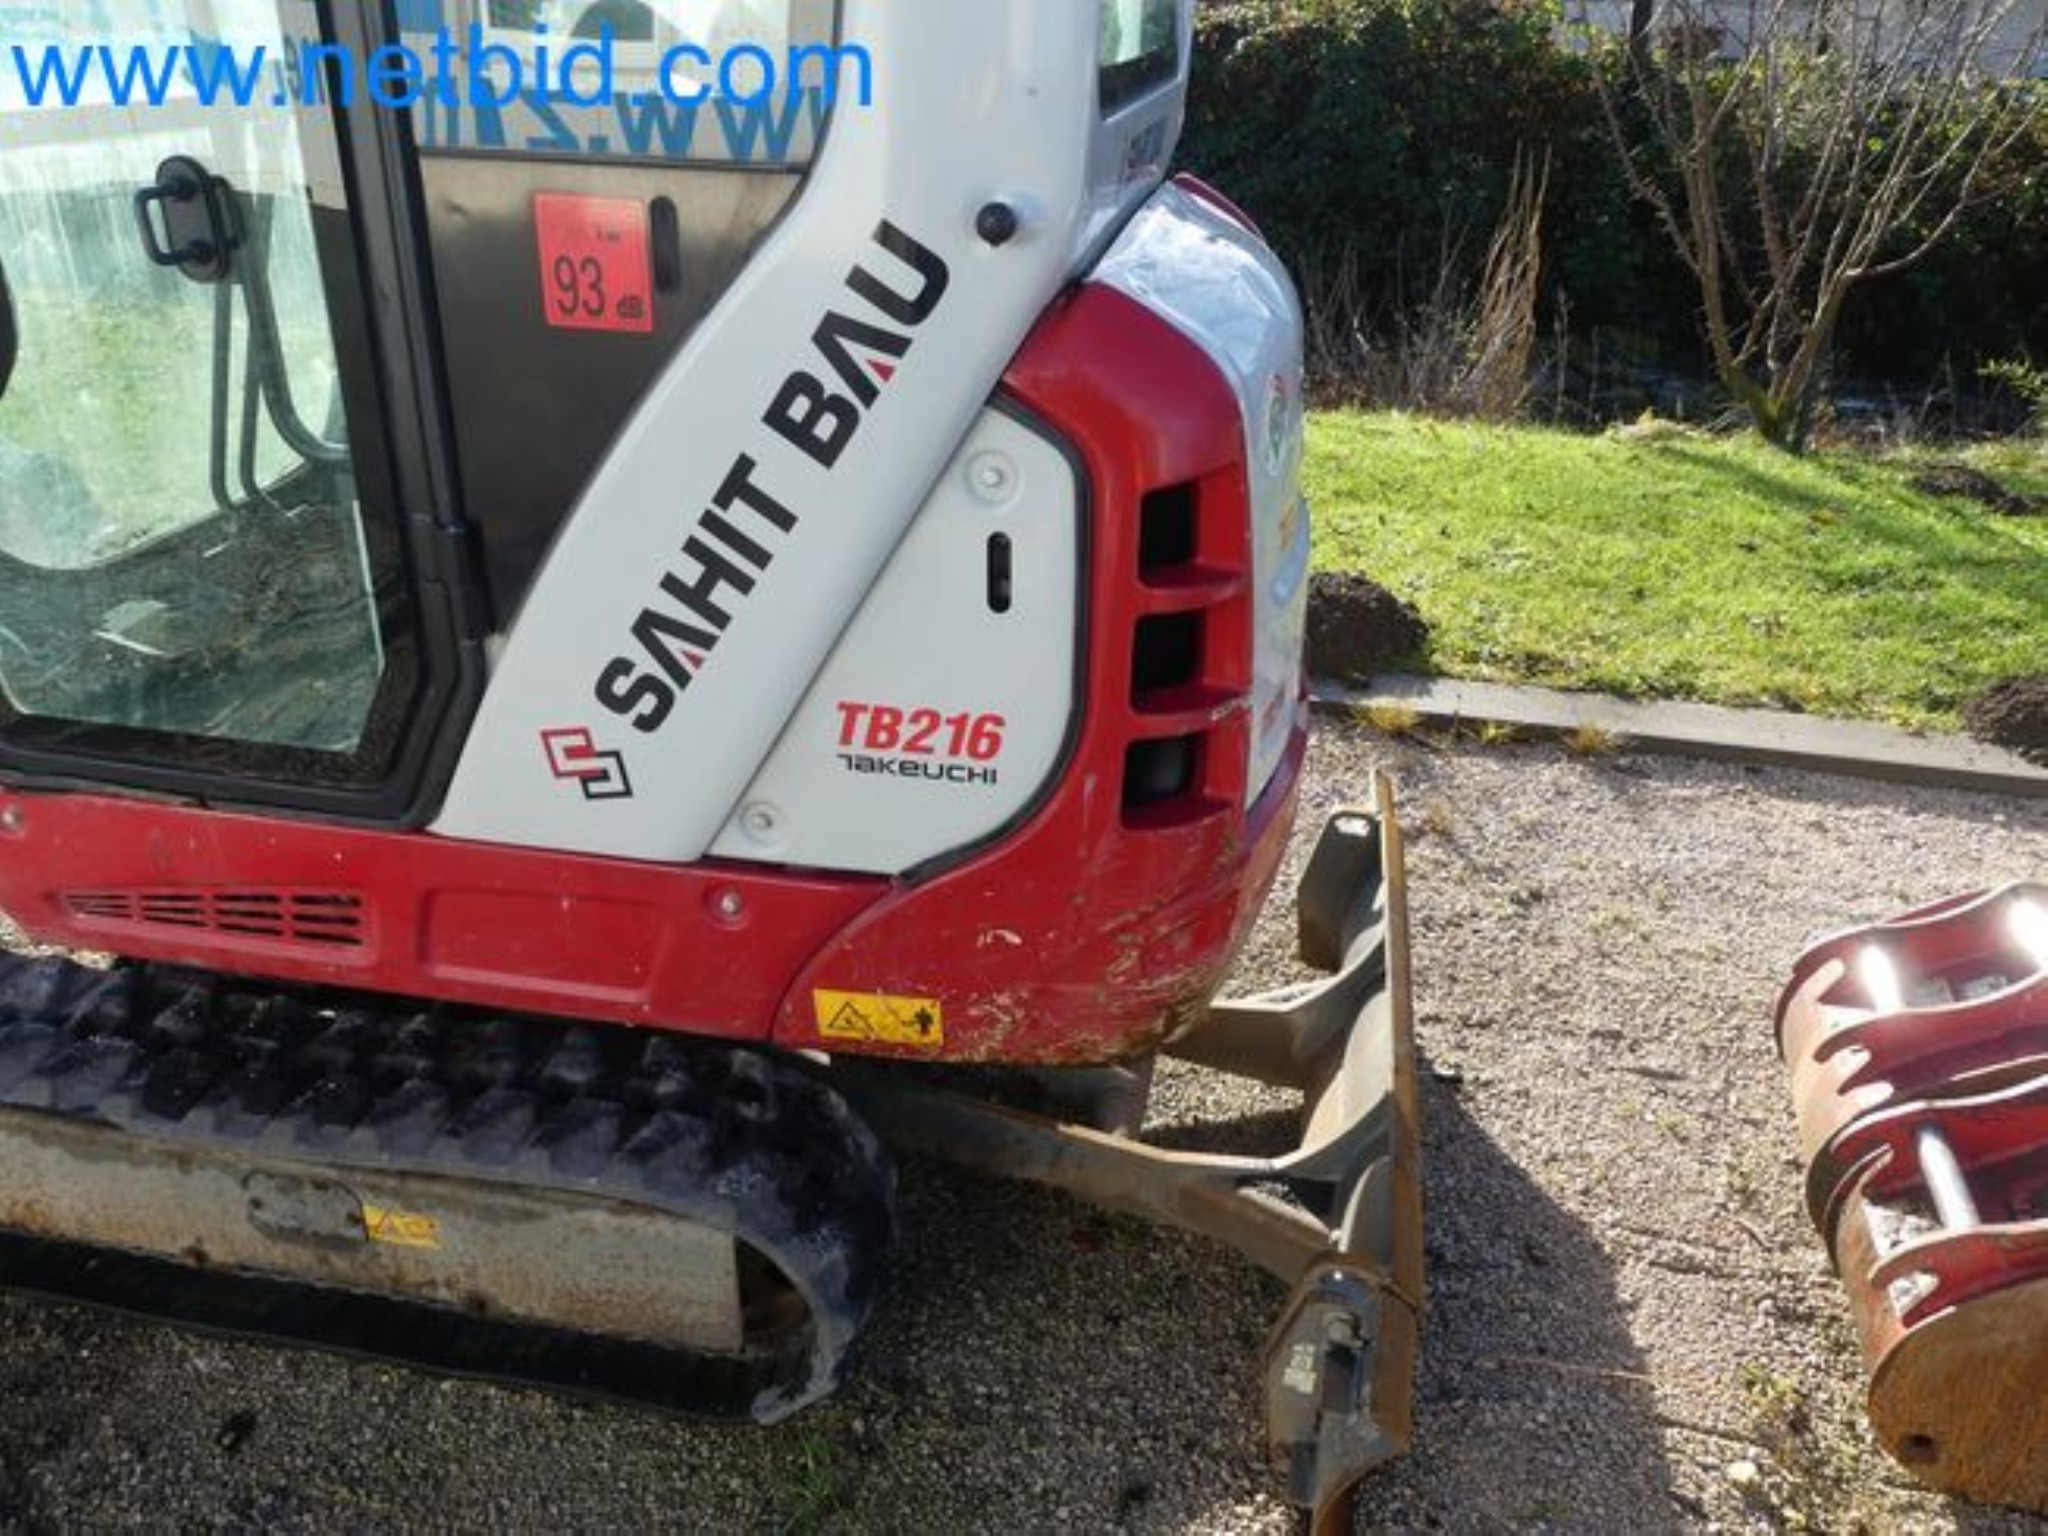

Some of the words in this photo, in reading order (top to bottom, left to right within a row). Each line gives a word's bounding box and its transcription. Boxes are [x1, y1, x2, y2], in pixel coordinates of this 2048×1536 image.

[554, 256, 605, 316] 93
[594, 452, 799, 734] SAHIT
[762, 219, 950, 469] BAU
[836, 701, 1005, 761] TB216
